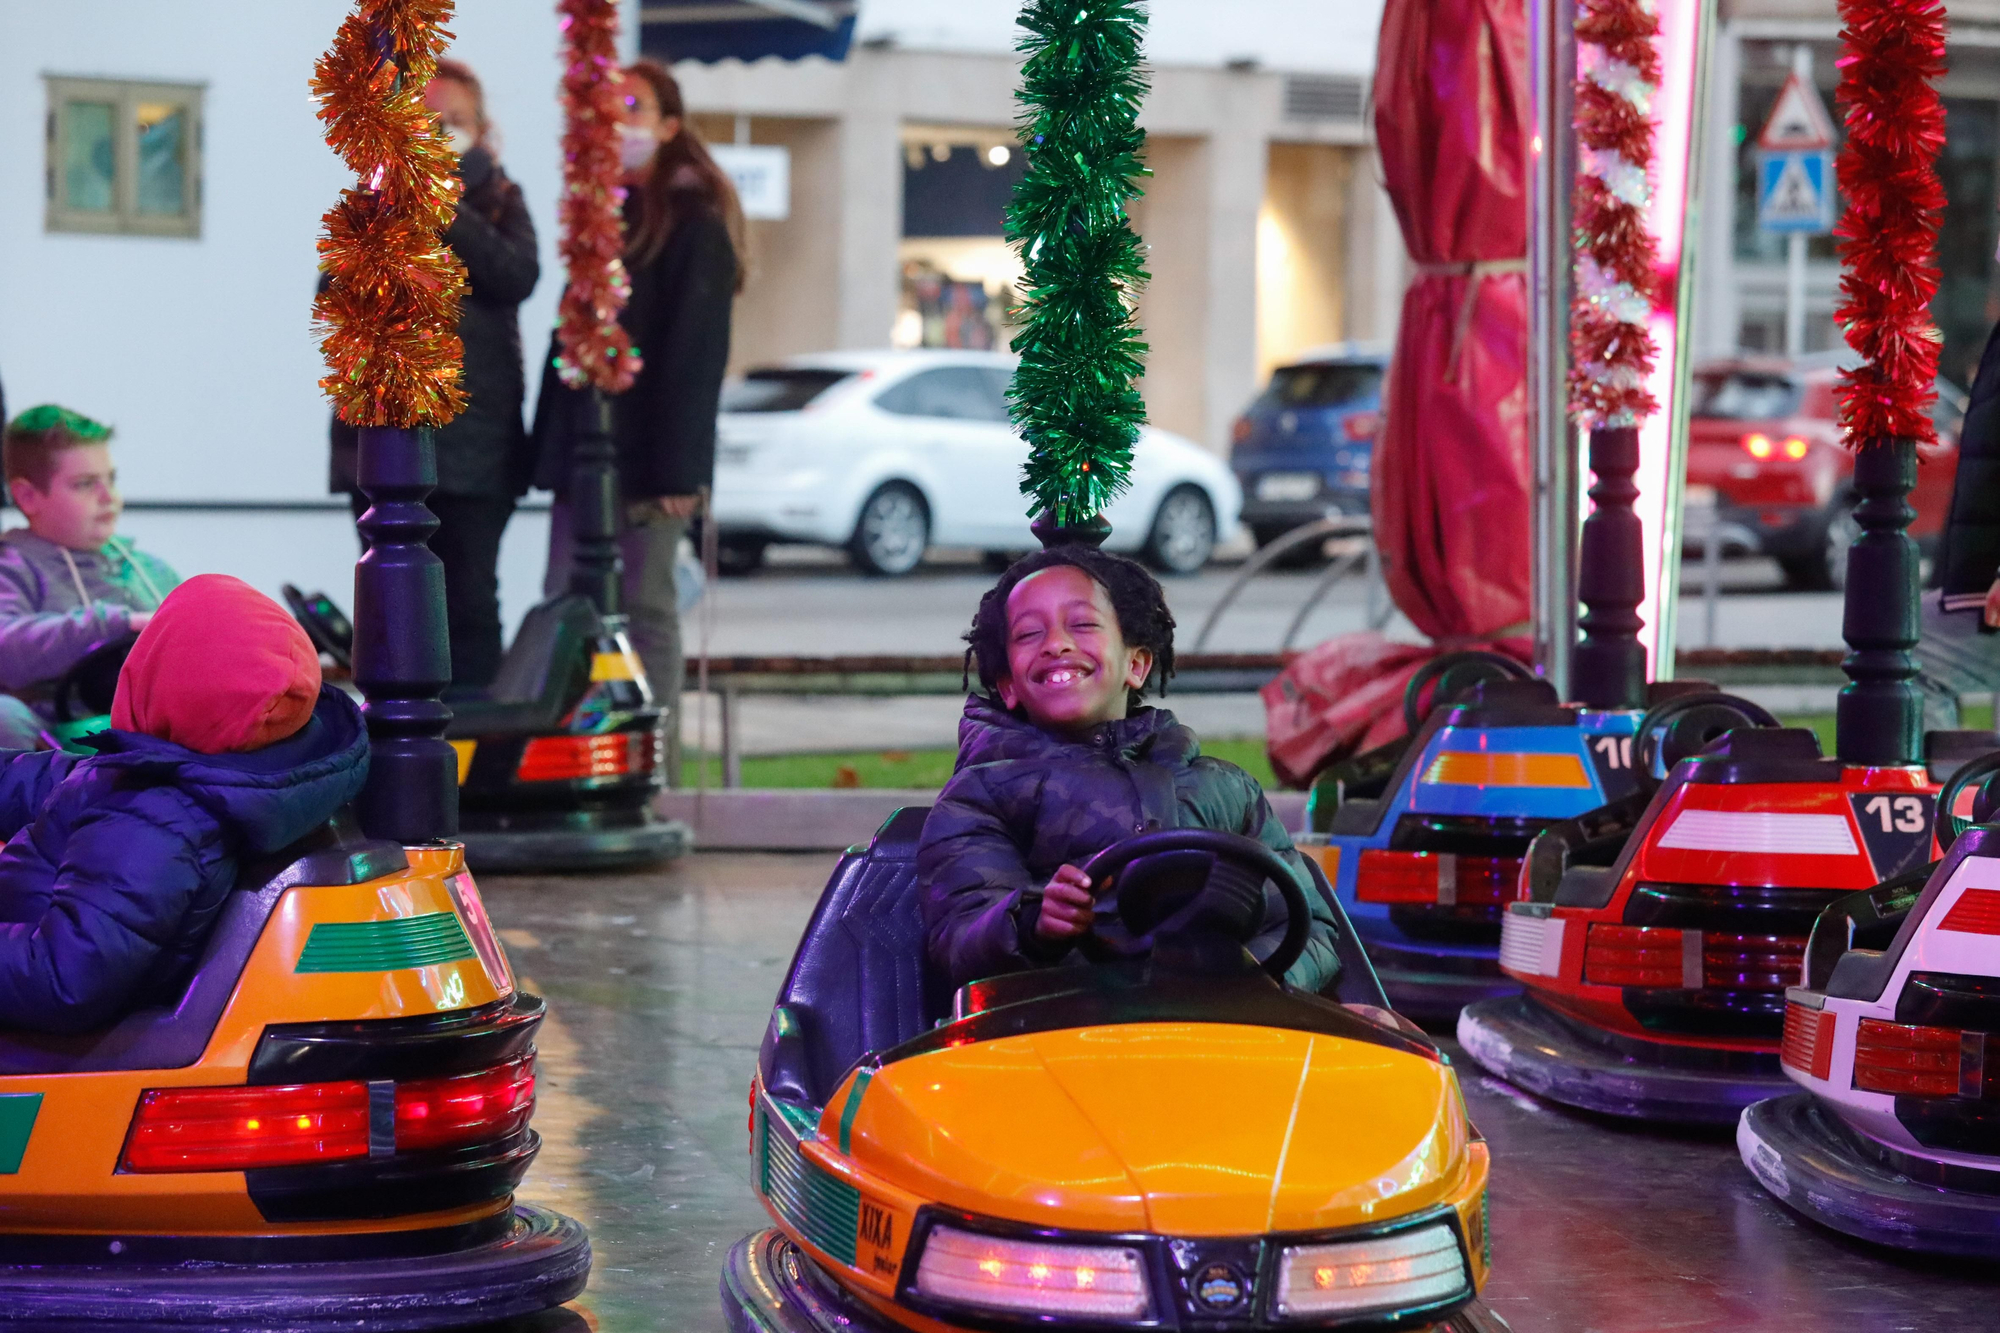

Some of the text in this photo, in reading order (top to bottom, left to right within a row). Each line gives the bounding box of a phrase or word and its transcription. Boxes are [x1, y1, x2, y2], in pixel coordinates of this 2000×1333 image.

[1865, 796, 1925, 832] 13
[455, 881, 478, 924] 5
[860, 1202, 892, 1249] XIXA
